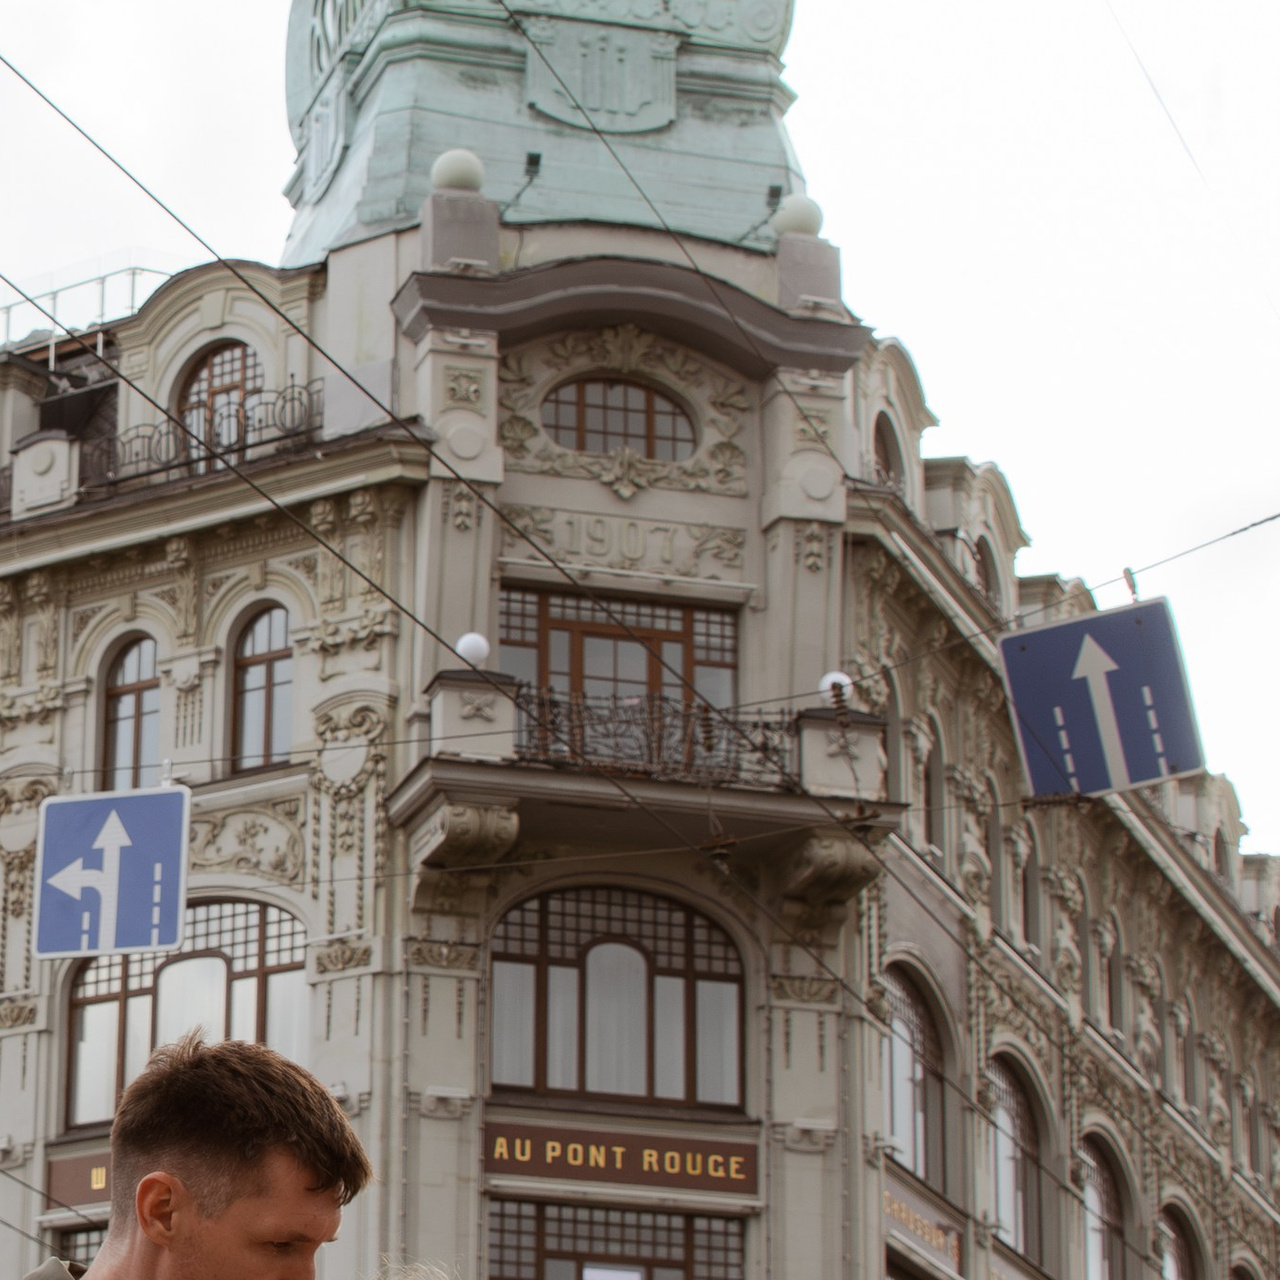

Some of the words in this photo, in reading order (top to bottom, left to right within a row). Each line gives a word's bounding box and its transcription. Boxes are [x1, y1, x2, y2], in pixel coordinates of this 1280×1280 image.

[493, 1136, 532, 1163] AU
[545, 1140, 626, 1170] PONT
[642, 1148, 746, 1180] ROUGE
